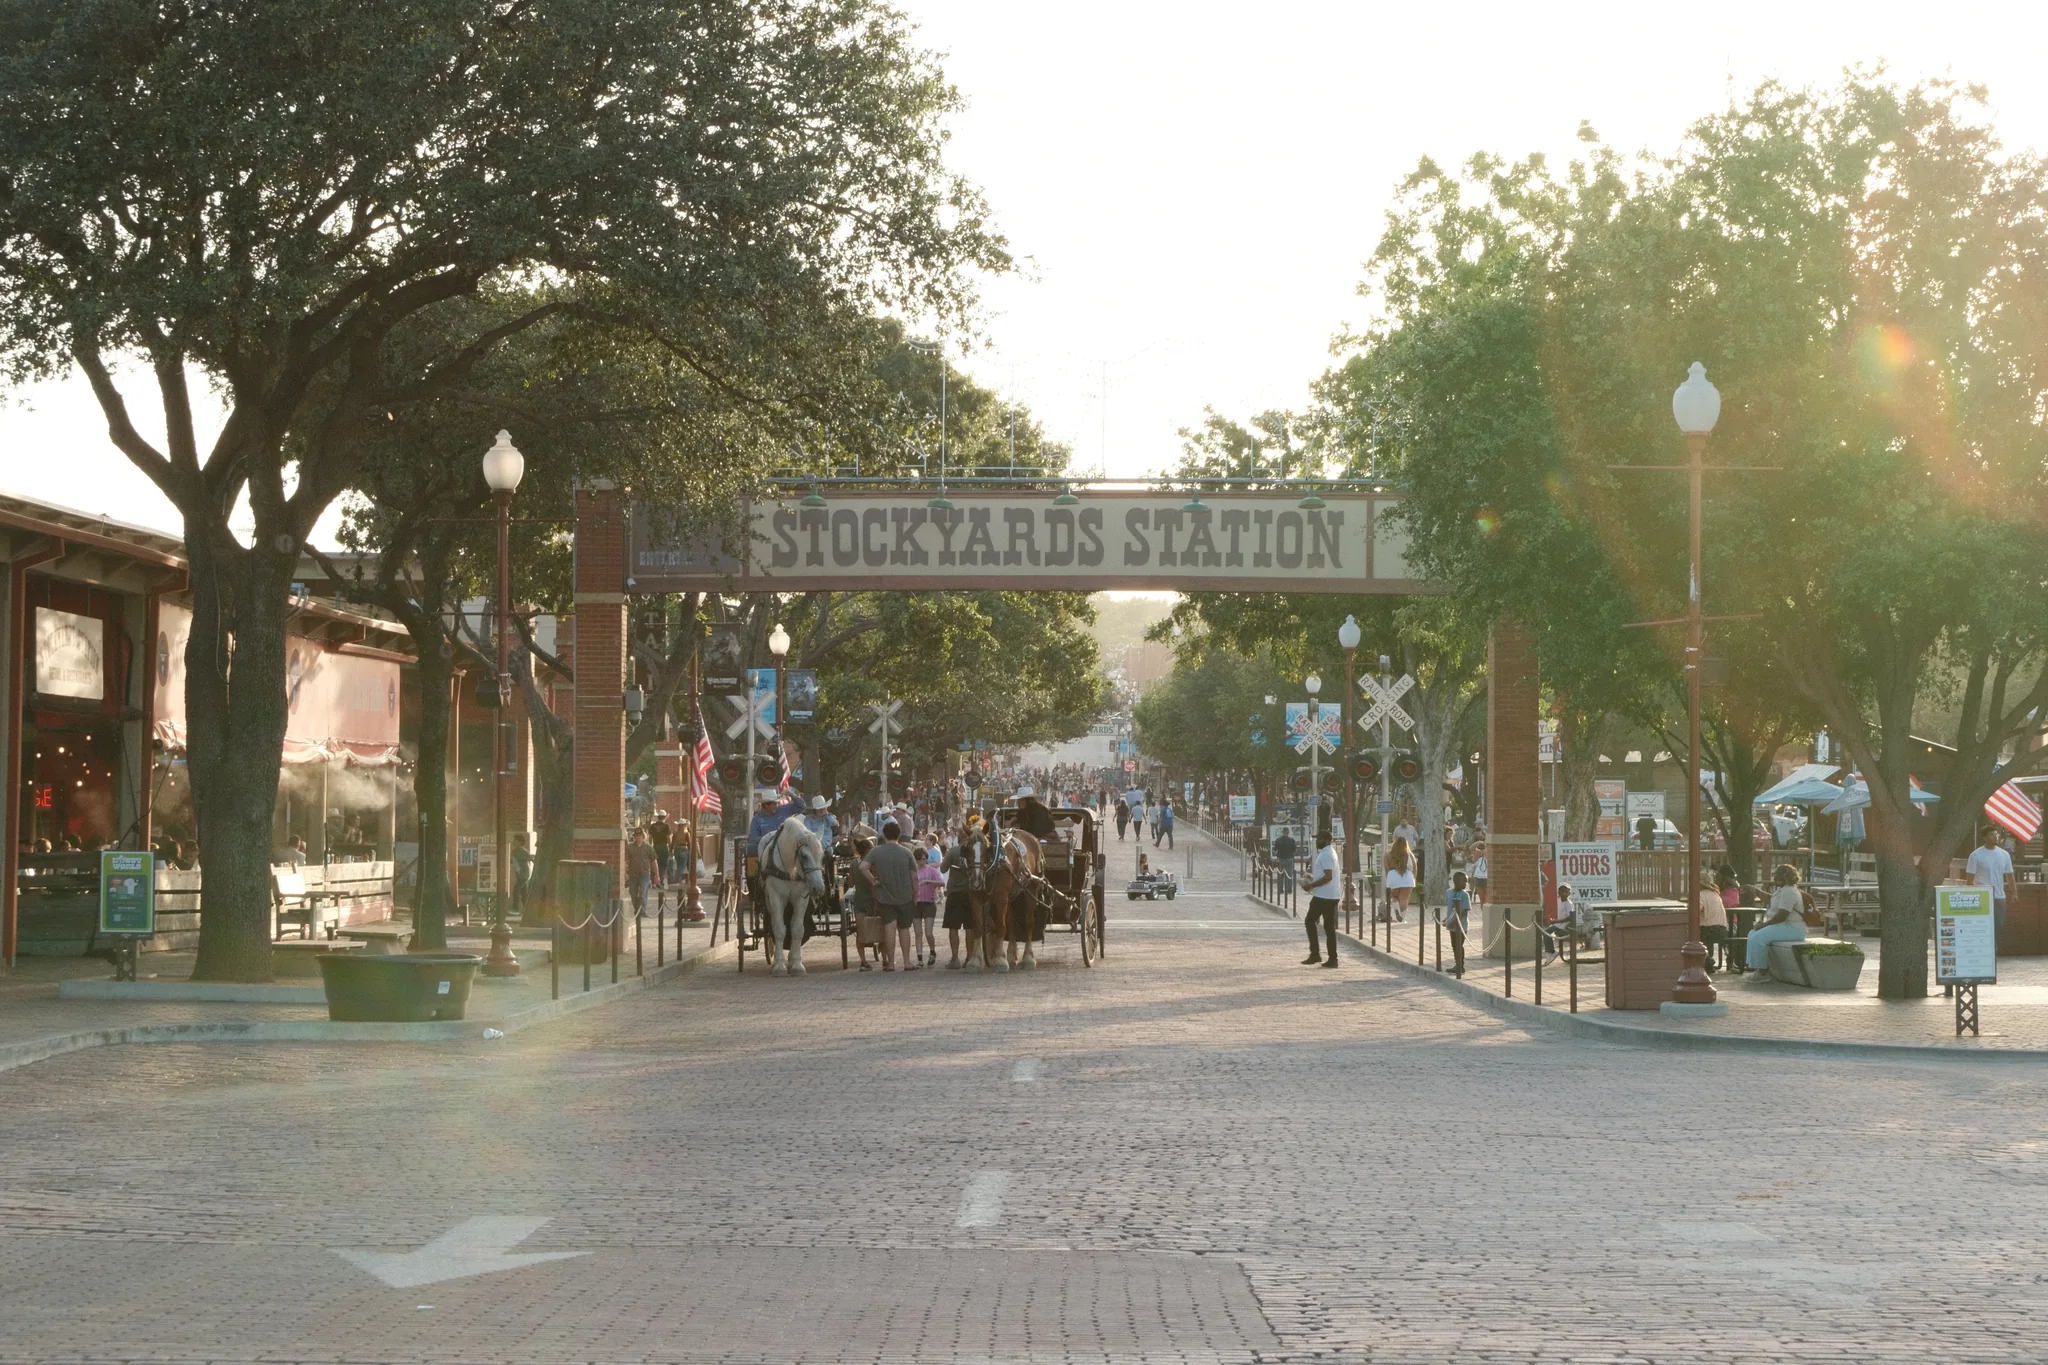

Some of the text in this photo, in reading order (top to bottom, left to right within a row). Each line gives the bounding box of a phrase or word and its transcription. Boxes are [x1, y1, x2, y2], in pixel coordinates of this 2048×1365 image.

[772, 507, 1344, 569] STOCKYARDS STATION
[1360, 676, 1412, 728] RAIL ROAD
[1362, 678, 1410, 726] CROSSING
[1297, 714, 1334, 753] RAIL ROAD
[1298, 715, 1334, 752] CROSSING
[1560, 854, 1610, 876] TOURS
[1578, 888, 1612, 898] WEST
